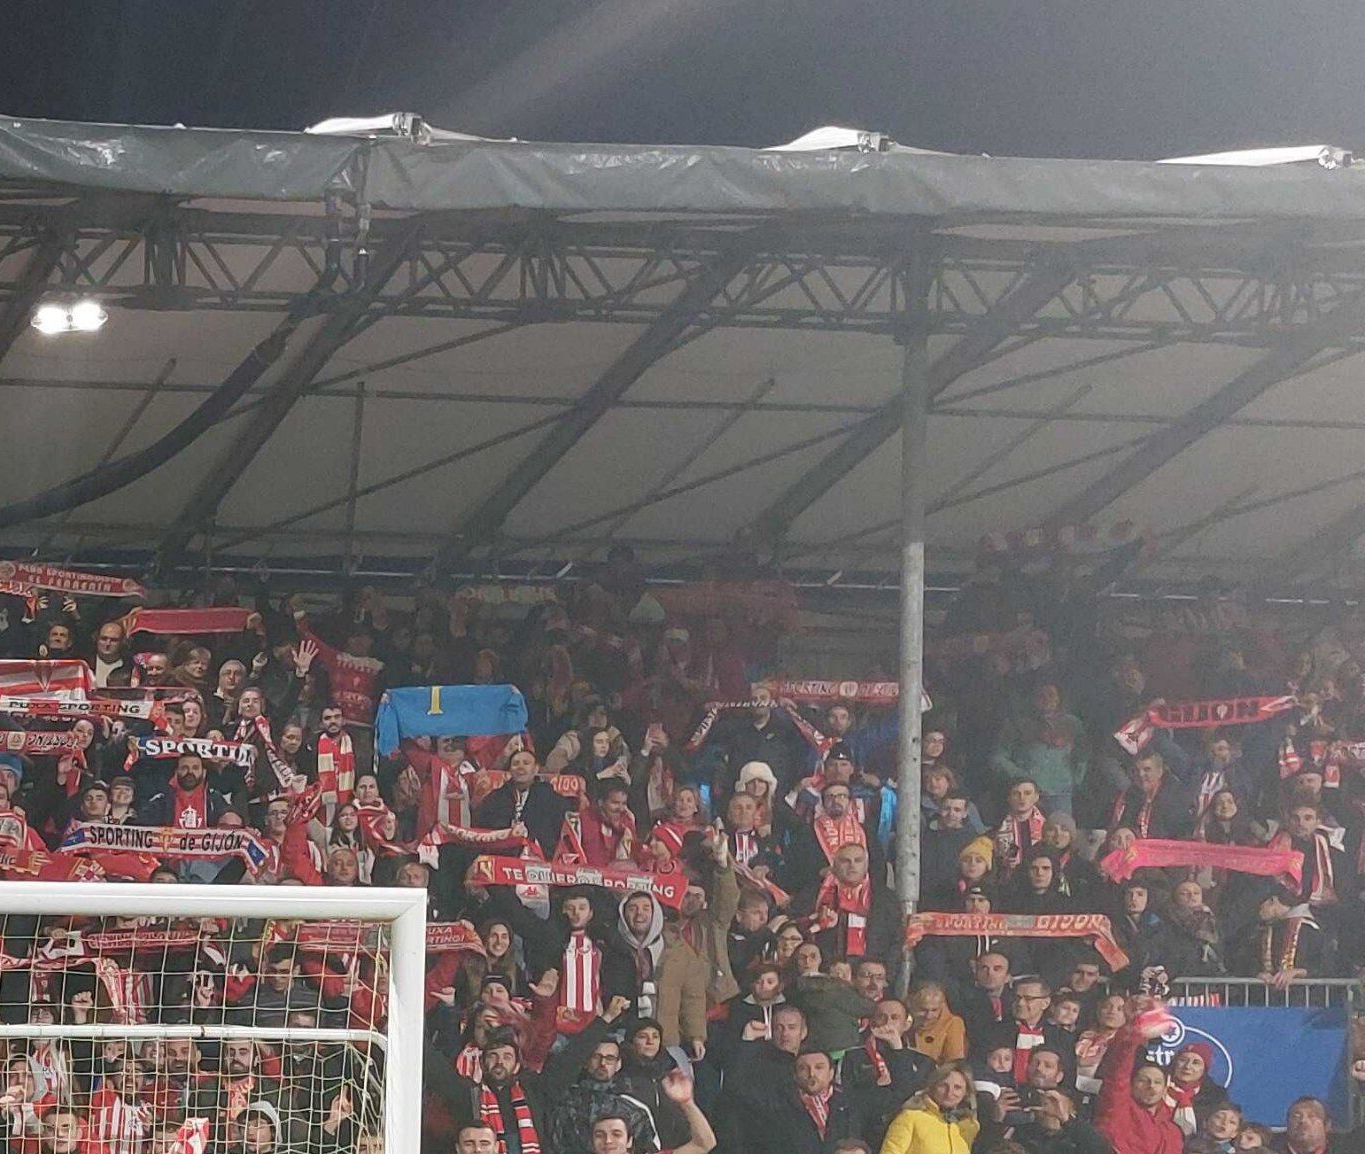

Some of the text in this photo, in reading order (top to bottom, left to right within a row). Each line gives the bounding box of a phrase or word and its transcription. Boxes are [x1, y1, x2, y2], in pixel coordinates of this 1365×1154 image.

[58, 702, 140, 714] SPORTING
[89, 825, 153, 848] SPORTING
[179, 832, 196, 849] de
[502, 866, 525, 881] TE
